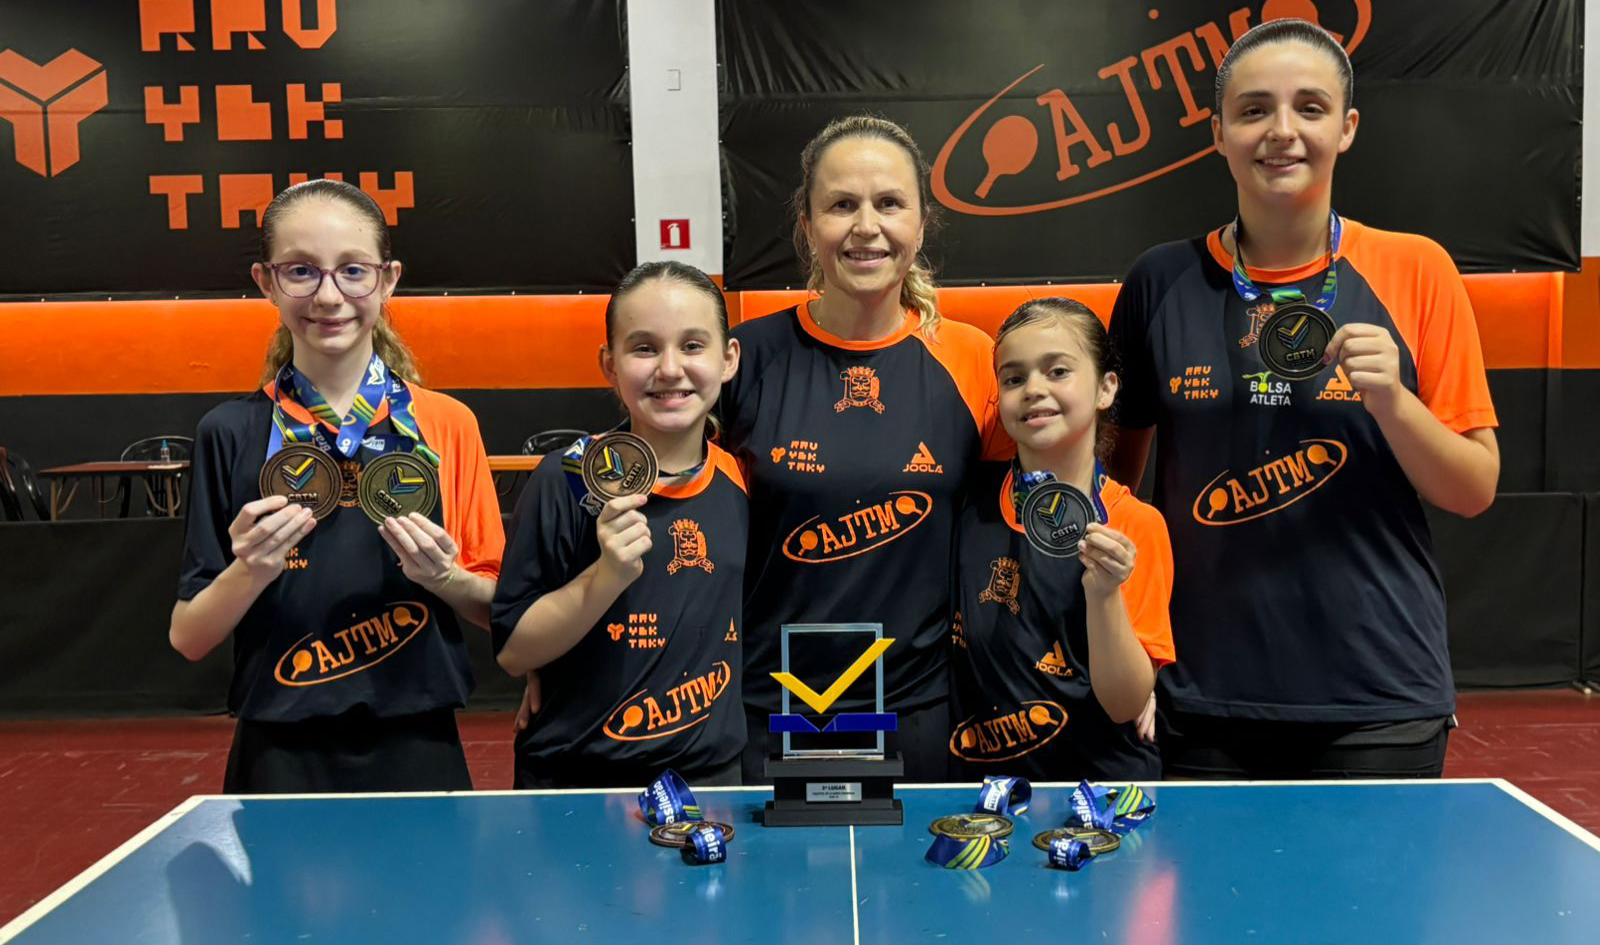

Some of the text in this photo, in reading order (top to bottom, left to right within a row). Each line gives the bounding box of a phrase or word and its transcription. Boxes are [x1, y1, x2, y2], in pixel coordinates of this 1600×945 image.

[149, 171, 415, 229] TAY
[1286, 348, 1316, 361] CBTM
[1250, 394, 1292, 406] ATLETA
[1315, 391, 1361, 401] JOOLA
[902, 463, 943, 474] JOOLA
[1226, 450, 1315, 513] AJTM
[817, 500, 900, 554] AJTM
[1051, 523, 1078, 539] CBTM
[311, 612, 399, 674] AJTM
[1033, 660, 1073, 676] JOOLA
[645, 671, 716, 730] AJTM
[975, 710, 1038, 753] AJTM
